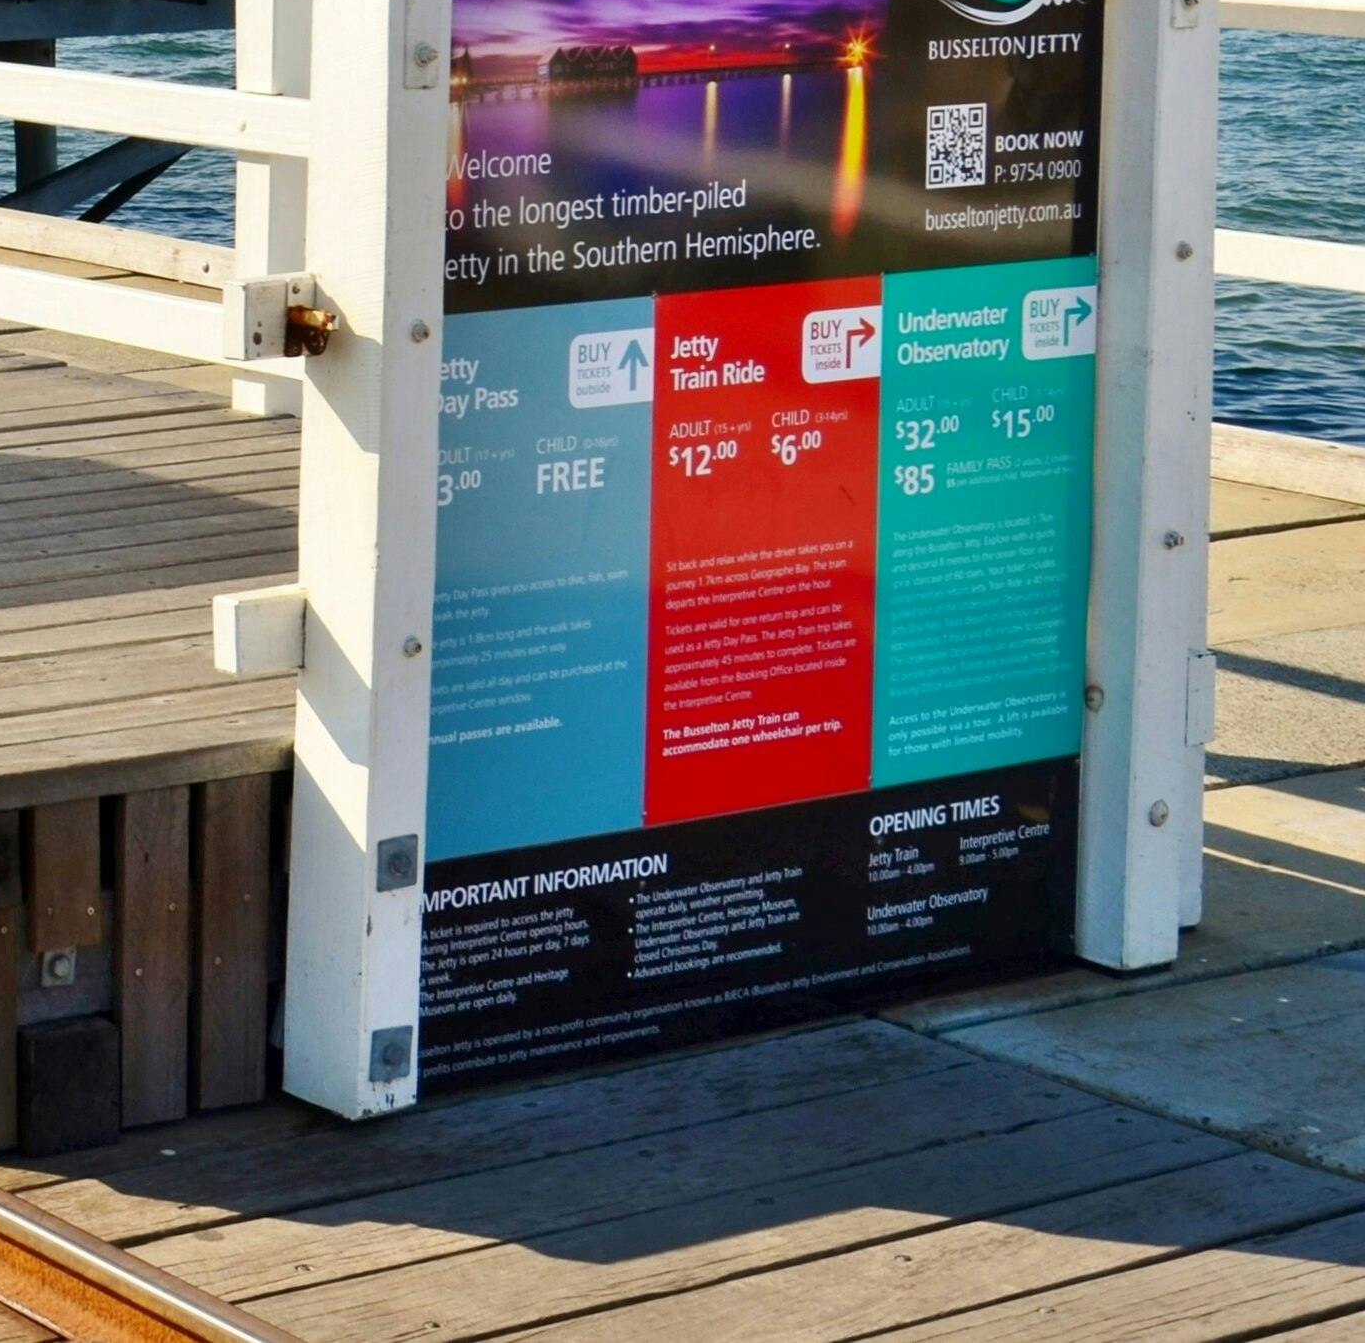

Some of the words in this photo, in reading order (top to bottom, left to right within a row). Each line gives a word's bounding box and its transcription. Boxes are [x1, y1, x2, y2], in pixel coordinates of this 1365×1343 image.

[928, 35, 1026, 60] BUSSELTON
[1026, 33, 1081, 59] JETTY
[995, 133, 1039, 153] BOOK
[1043, 130, 1083, 149] NOW
[445, 149, 552, 181] Welcome
[994, 164, 1006, 183] P:
[1009, 161, 1044, 183] 9754
[1047, 159, 1081, 180] 0900
[472, 198, 511, 228] the
[519, 193, 604, 229] longest
[610, 177, 747, 218] timber-piled
[924, 202, 1081, 232] busseltonjetty.com.au
[444, 253, 490, 285] etty
[498, 247, 518, 275] in
[526, 242, 565, 273] the
[572, 235, 677, 269] Southern
[685, 224, 820, 260] Hemisphere.
[898, 306, 1008, 334] Underwater
[1030, 298, 1060, 318] BUY
[810, 319, 842, 340] BUY
[1028, 320, 1060, 333] TICKETS
[578, 341, 612, 364] BUY
[670, 335, 719, 362] Jetty
[809, 342, 842, 355] TICKETS
[897, 338, 1009, 365] Observatory
[438, 357, 479, 388] etty
[577, 366, 612, 379] TICKETS
[669, 364, 718, 391] Train
[722, 359, 765, 386] Ride
[815, 357, 842, 370] inside
[474, 387, 518, 410] Pass
[668, 419, 712, 439] ADULT
[771, 408, 810, 428] CHILD
[991, 404, 1054, 438] $15.00
[535, 434, 578, 455] CHILD
[895, 414, 960, 451] $32.00
[436, 446, 472, 468] DULT
[669, 439, 737, 477] $12.00
[771, 430, 822, 465] $6.00
[437, 469, 481, 506] 3.00
[537, 456, 605, 494] FREE
[894, 463, 934, 495] $85
[429, 730, 457, 746] nnual
[662, 728, 682, 740] The
[683, 721, 730, 738] Busselton
[731, 717, 755, 730] Jetty
[757, 713, 781, 725] Train
[782, 711, 799, 722] can
[662, 737, 730, 757] accommodate
[730, 734, 751, 746] one
[751, 724, 804, 742] wheelchair
[804, 723, 821, 736] per
[822, 719, 842, 732] trip.
[869, 804, 946, 836] OPENING
[949, 794, 1000, 822] TIMES
[959, 828, 1016, 850] Interpretive
[1017, 823, 1050, 839] Centre
[868, 851, 893, 868] Jetty
[894, 845, 919, 862] Train
[421, 875, 530, 914] MPORTANT
[534, 853, 667, 894] INFORMATION
[867, 899, 927, 921] Underwater
[928, 888, 988, 909] Observatory
